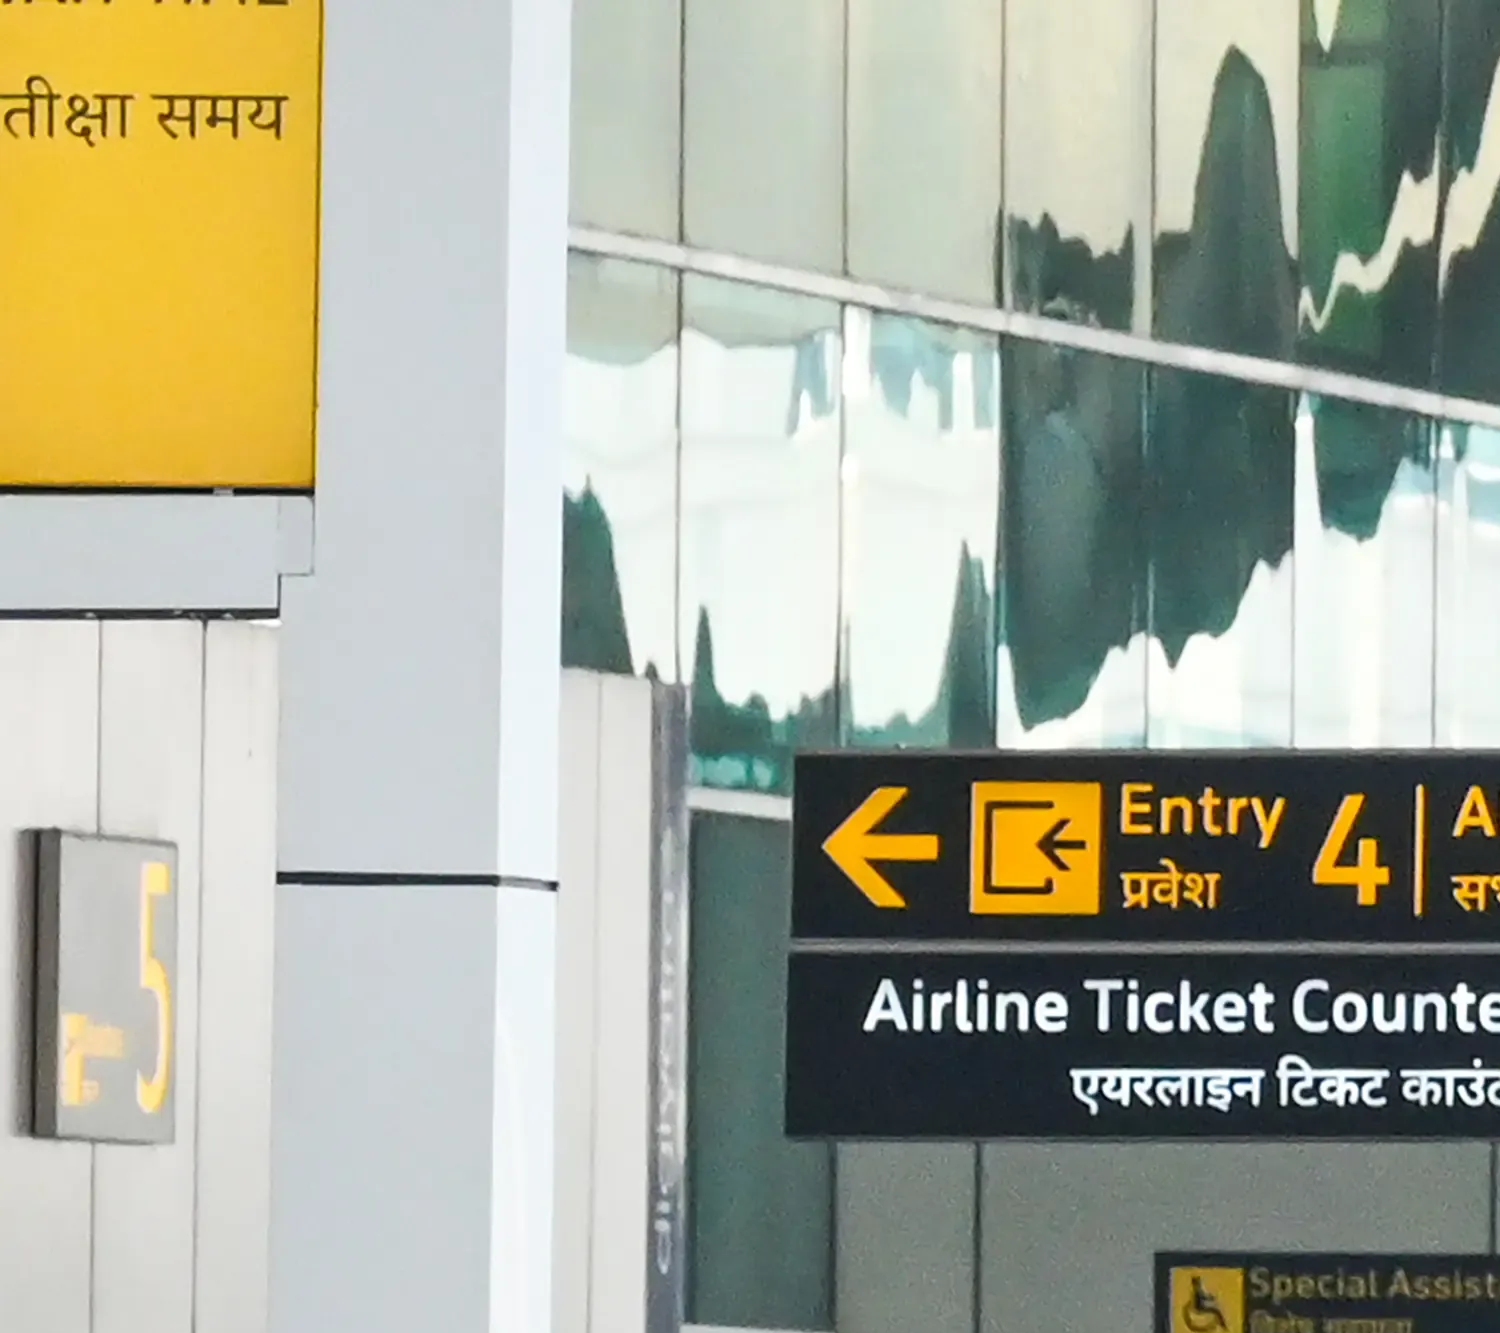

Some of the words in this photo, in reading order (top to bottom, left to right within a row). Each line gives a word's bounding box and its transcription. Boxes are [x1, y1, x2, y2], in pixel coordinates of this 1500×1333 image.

[0, 76, 134, 147] तीक्षा
[150, 94, 288, 140] समय
[1120, 782, 1285, 848] Entry
[1312, 793, 1390, 905] 4
[1120, 857, 1221, 908] प्रवेश
[137, 861, 171, 1114] 5
[862, 978, 1068, 1033] Airline
[1083, 978, 1275, 1033] Ticket
[1069, 1068, 1265, 1115] एयरलाइन
[1276, 1054, 1390, 1107] टिकट
[1249, 1266, 1377, 1305] Special
